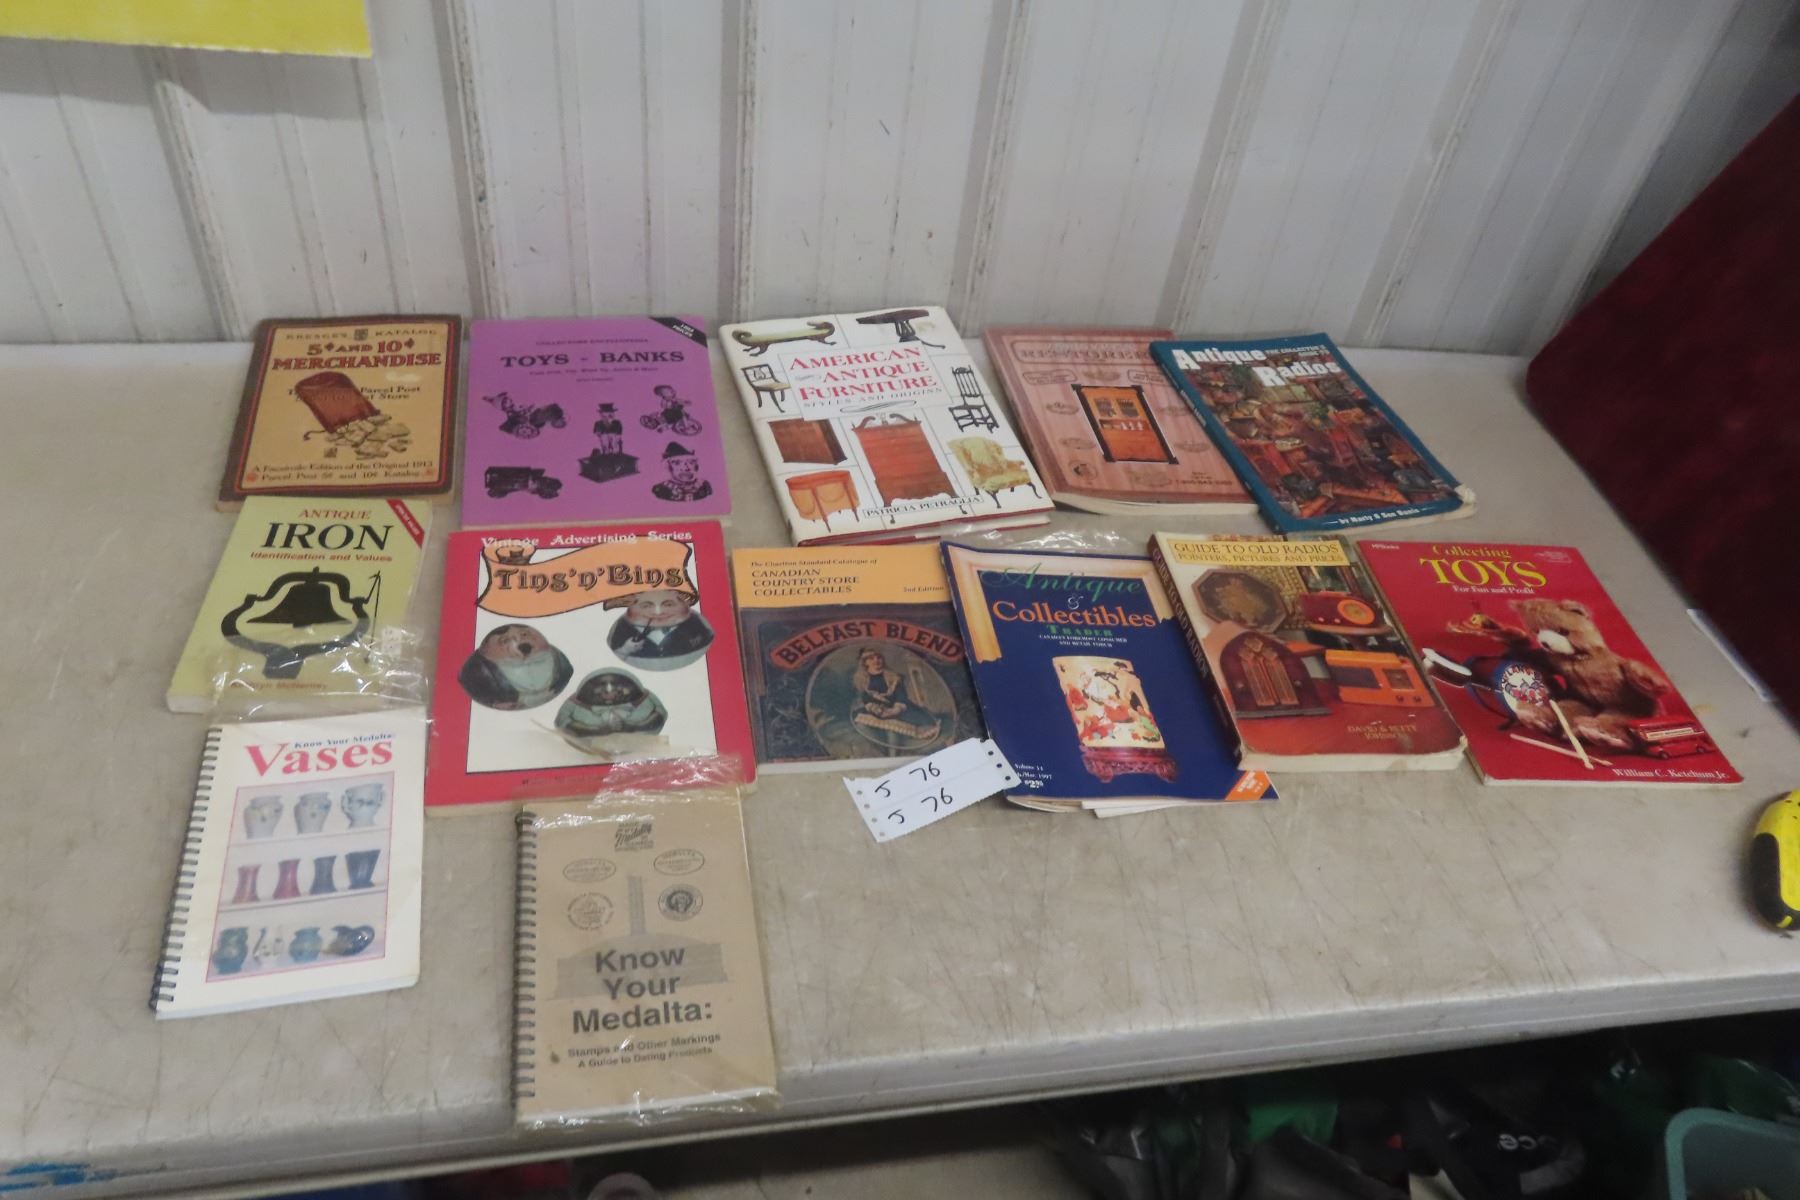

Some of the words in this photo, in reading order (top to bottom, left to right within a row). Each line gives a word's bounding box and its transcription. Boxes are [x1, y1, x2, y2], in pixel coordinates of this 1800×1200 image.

[335, 344, 374, 353] AND
[789, 346, 922, 371] AMERICAN
[1172, 347, 1268, 370] Antique
[272, 353, 441, 371] MERCHANDISE
[501, 353, 569, 368] TOYS
[600, 351, 685, 364] BANKS
[823, 361, 930, 384] ANTIQUE
[1251, 360, 1342, 387] Radios
[396, 385, 421, 393] Post
[799, 375, 938, 401] FURNITURE
[297, 509, 372, 520] ANTIQUE
[866, 504, 917, 517] PATRICIA
[919, 496, 981, 511] PETRAGLIA
[261, 522, 395, 551] IRON
[481, 536, 540, 548] Vintage
[550, 531, 638, 547] Advertising
[647, 530, 693, 542] Series
[250, 551, 326, 562] Identification
[329, 552, 352, 562] and
[356, 554, 393, 563] Values
[1174, 542, 1221, 554] GUIDE
[1222, 543, 1246, 554] TO
[1248, 543, 1280, 555] OLD
[1283, 543, 1340, 555] RADIOS
[1432, 544, 1513, 560] Collecting
[752, 568, 821, 578] CANADIAN
[753, 577, 816, 588] COUNTRY
[819, 576, 860, 585] STORE
[980, 562, 1143, 602] Antique
[1419, 557, 1548, 589] TOYS
[754, 585, 853, 597] COLLECTABLES
[1452, 584, 1469, 593] For
[1470, 584, 1490, 594] Fun
[1490, 585, 1507, 594] and
[1507, 586, 1536, 595] Profit
[1067, 592, 1084, 610] &
[992, 600, 1157, 628] Collectibles
[775, 621, 878, 665] BELFAST
[886, 621, 960, 659] BLEND
[245, 740, 393, 777] Vases
[909, 762, 941, 781] 76
[1612, 768, 1654, 777] William
[921, 787, 953, 812] 76
[595, 947, 686, 974] Know
[602, 976, 681, 1000] Your
[573, 1000, 713, 1034] Medalta:
[568, 1046, 611, 1058] Stamps
[636, 1040, 668, 1051] Other
[670, 1033, 721, 1048] Markings
